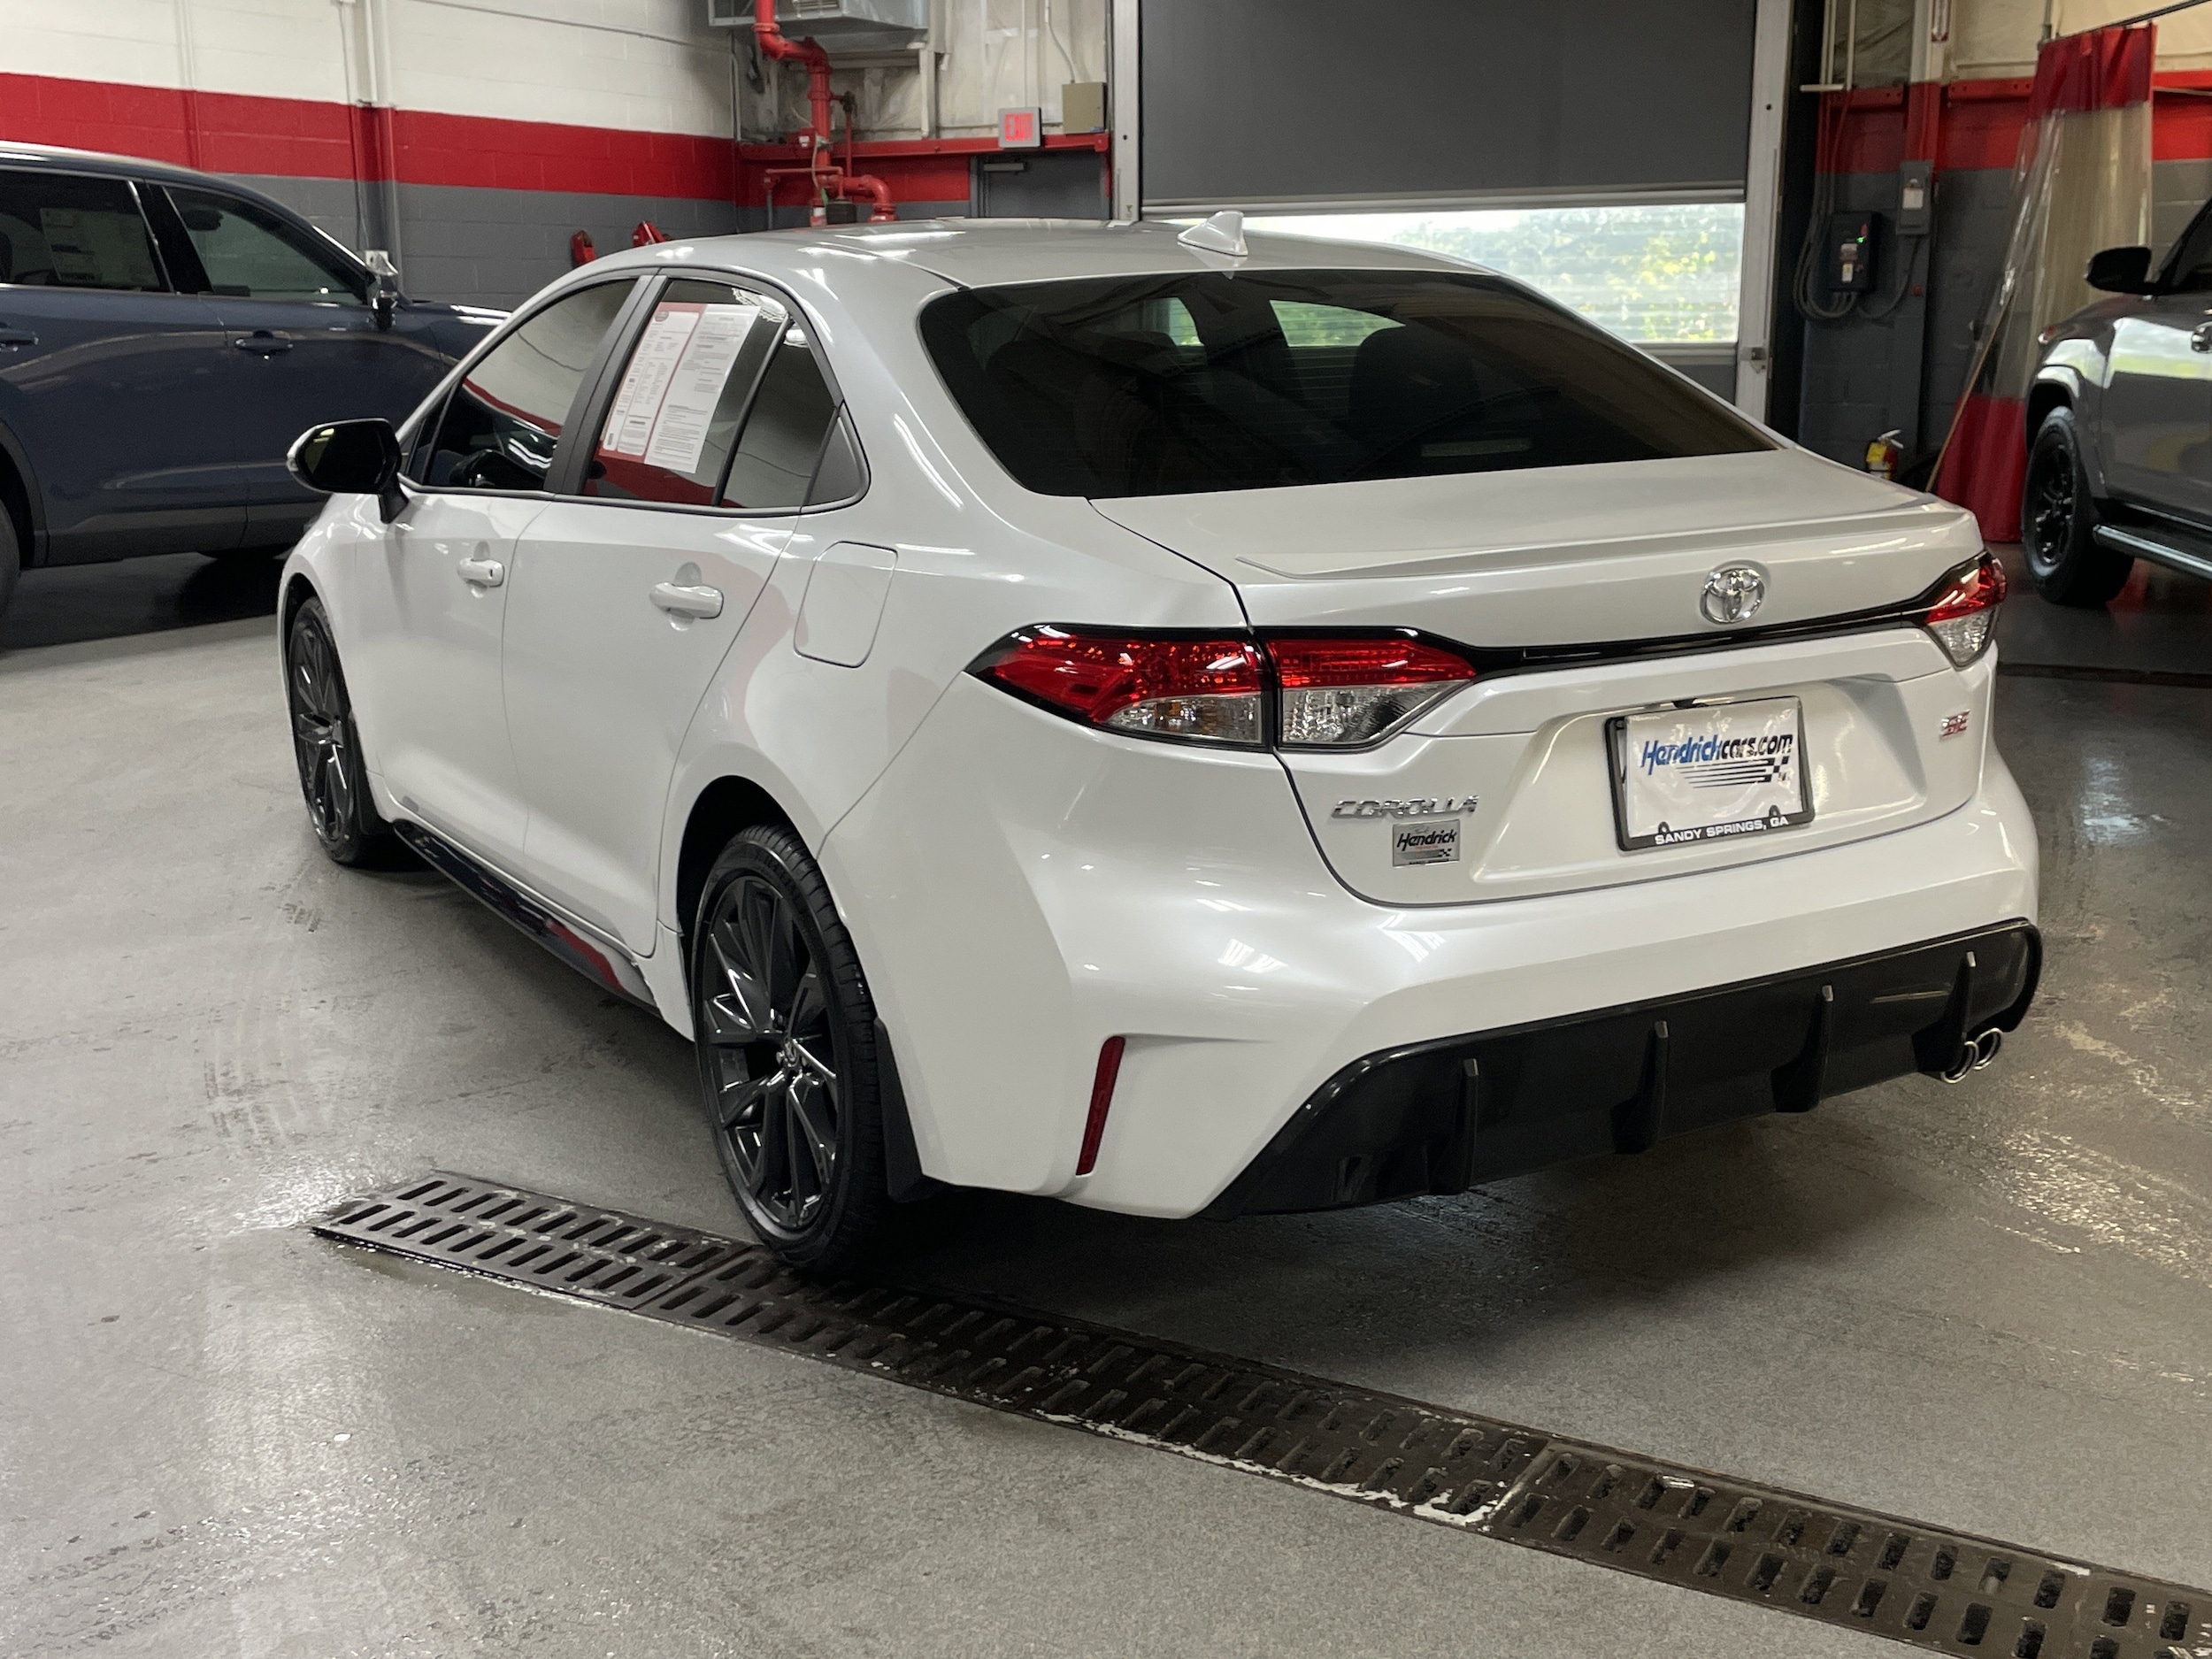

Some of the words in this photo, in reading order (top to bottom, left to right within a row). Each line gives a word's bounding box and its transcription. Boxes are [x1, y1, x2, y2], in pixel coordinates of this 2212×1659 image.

[1004, 112, 1033, 142] EXIT
[1331, 795, 1479, 819] COROLLA
[1396, 829, 1457, 851] Hendrick
[1654, 828, 1702, 846] SANDY
[1706, 819, 1767, 838] SPRINGS,
[1770, 816, 1789, 827] GA
